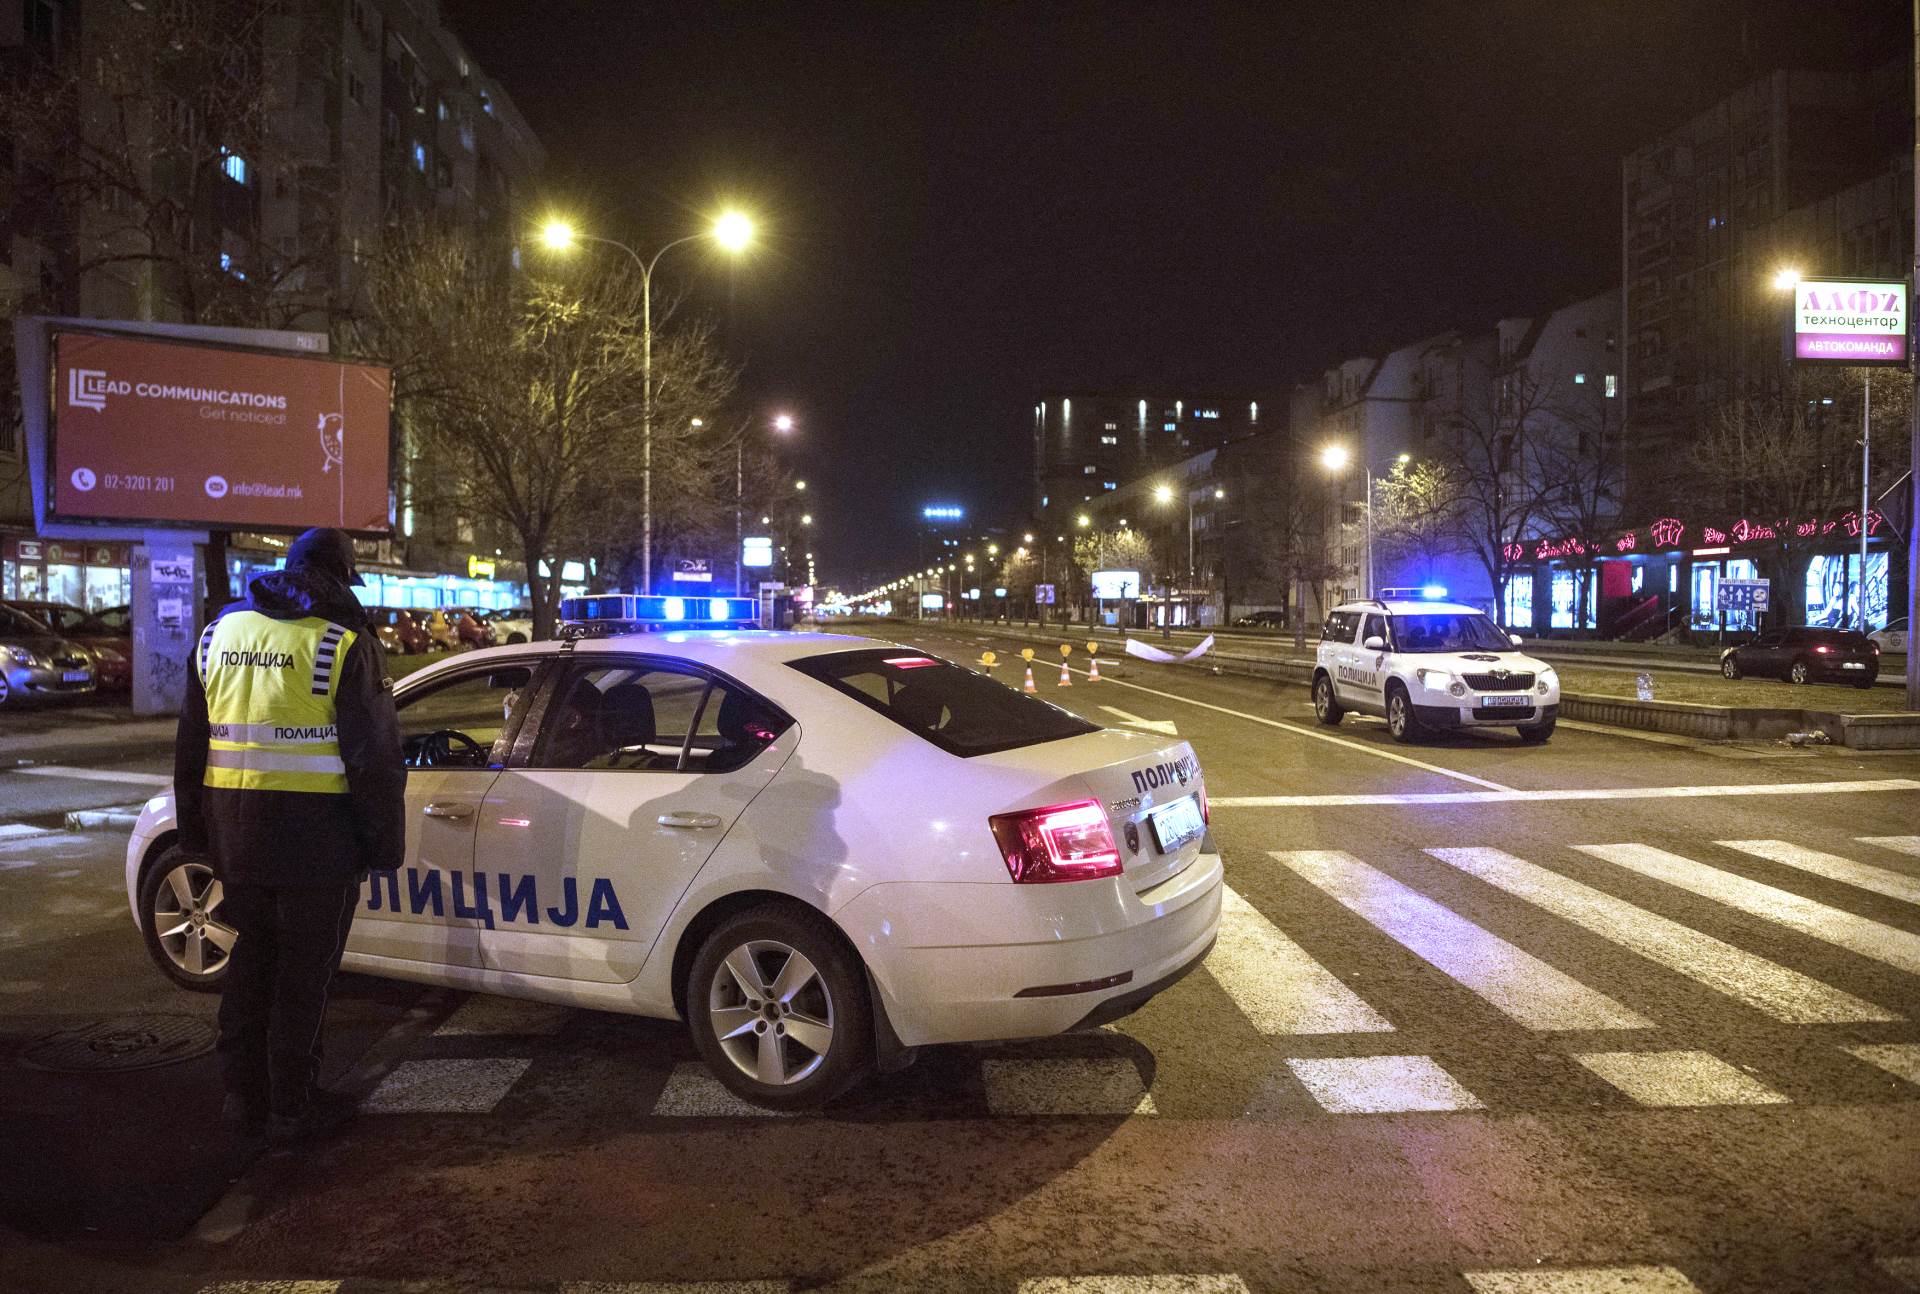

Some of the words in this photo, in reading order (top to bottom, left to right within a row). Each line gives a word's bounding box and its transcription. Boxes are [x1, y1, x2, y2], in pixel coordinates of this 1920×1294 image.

[1804, 315, 1898, 330] техноцентар
[1808, 340, 1894, 354] АВТОКОМАНДА
[135, 382, 287, 409] COMMUNICATIONS
[200, 406, 226, 421] Get
[230, 411, 287, 425] noticed!
[104, 474, 151, 492] 02-3201
[155, 477, 175, 492] 201
[232, 483, 303, 499] info@lead.mk
[220, 651, 295, 670] ПОЛИЦИЈА
[1338, 665, 1377, 686] ПОЛИЦИЈА
[208, 725, 229, 738] ЦИЈА
[274, 725, 338, 740] ПОЛИЦИЈ
[367, 868, 630, 931] ЛИЦИЈА
